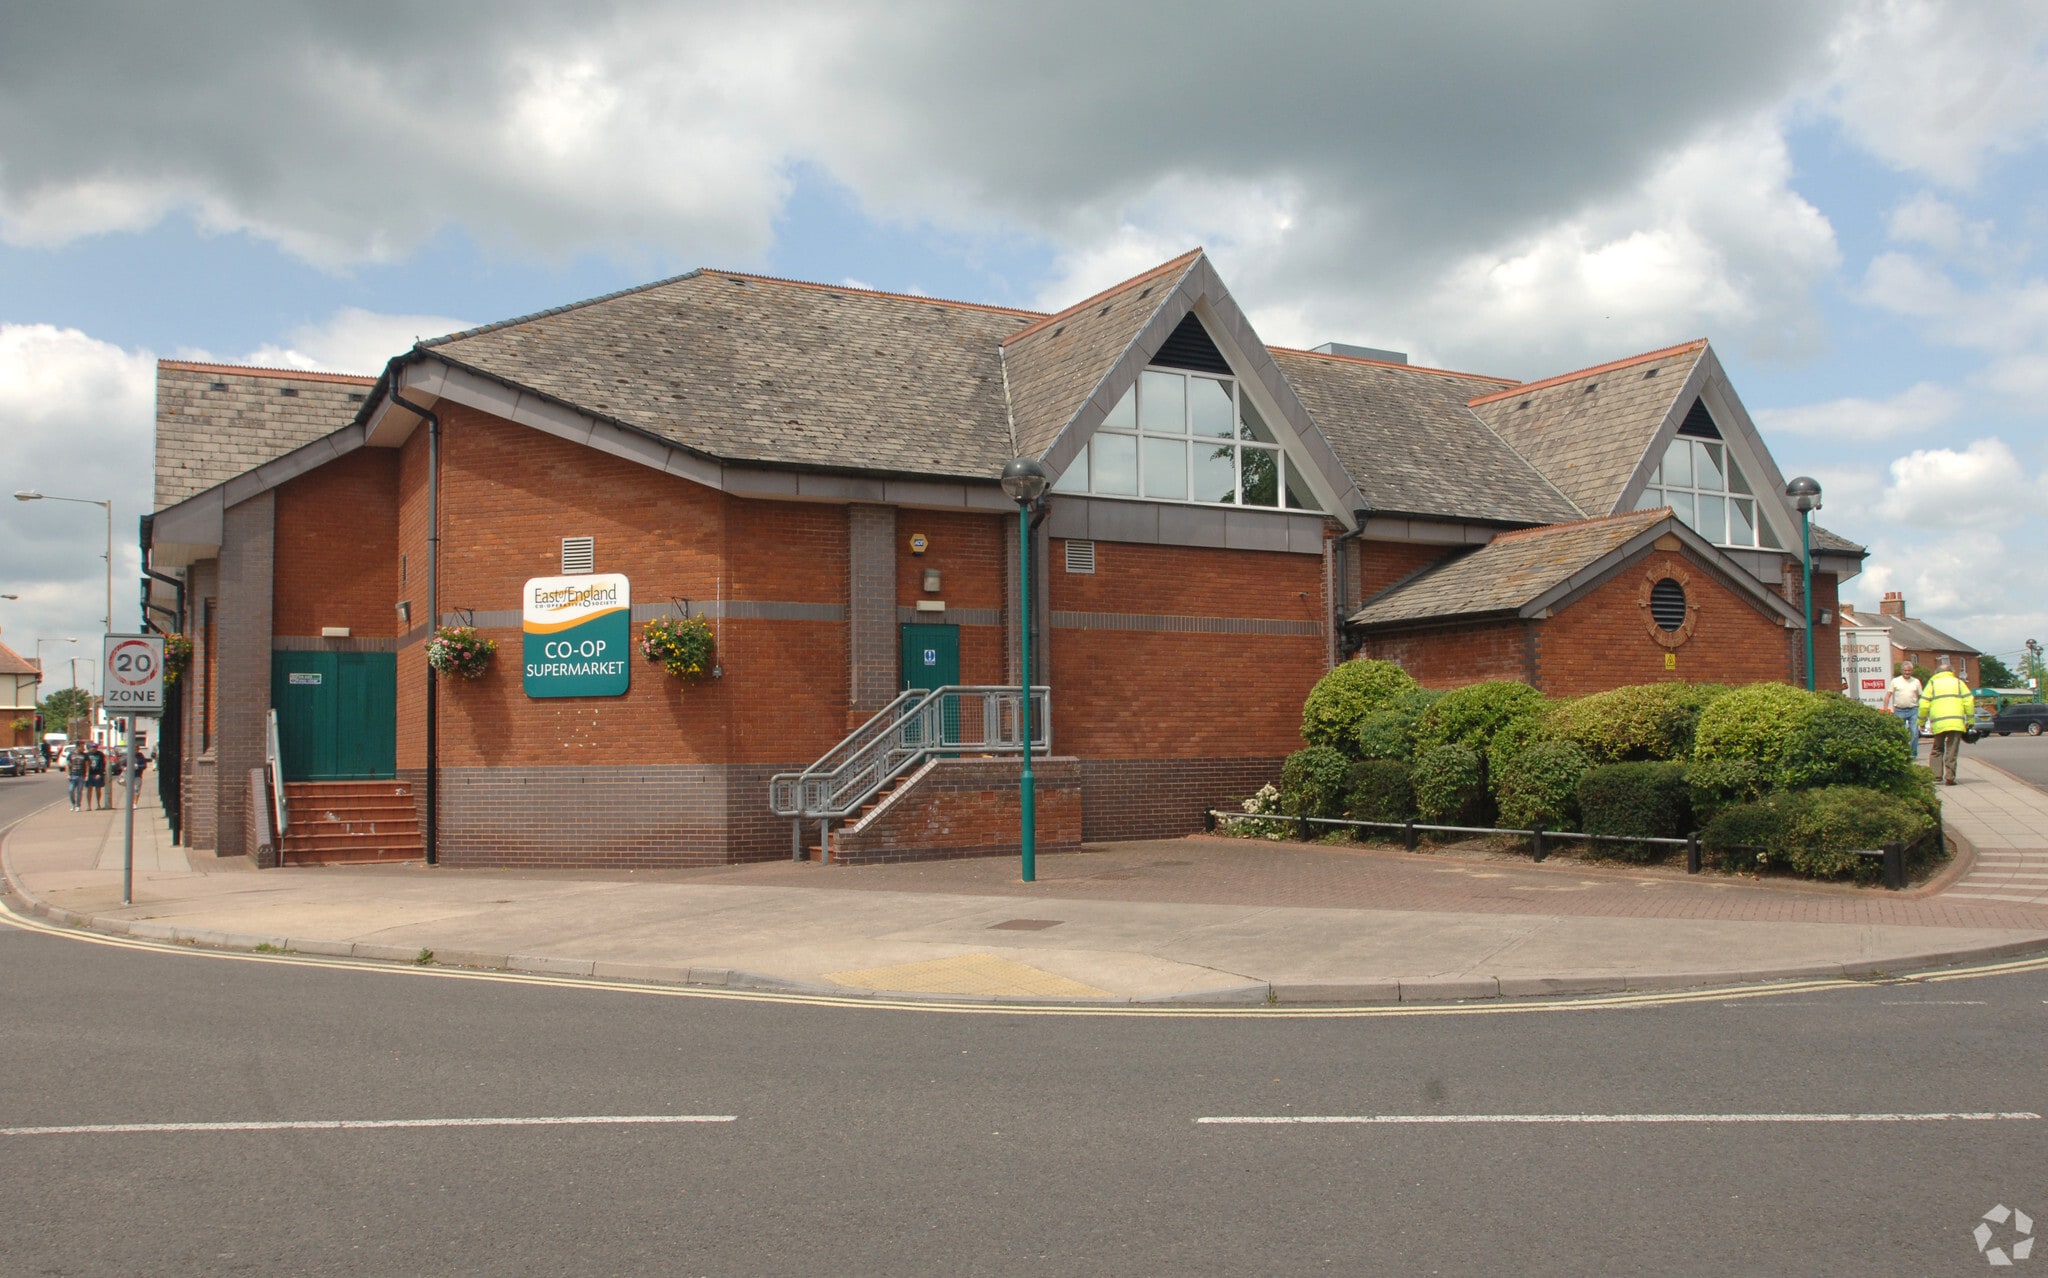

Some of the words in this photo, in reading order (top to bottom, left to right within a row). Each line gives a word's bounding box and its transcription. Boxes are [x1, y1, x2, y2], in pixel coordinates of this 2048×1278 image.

[535, 588, 560, 604] East
[567, 583, 617, 607] England
[544, 640, 607, 659] CO-OP
[1841, 644, 1880, 654] BRIDGE
[117, 653, 152, 672] 20
[526, 661, 625, 677] SUPERMARKET
[109, 690, 156, 702] ZONE
